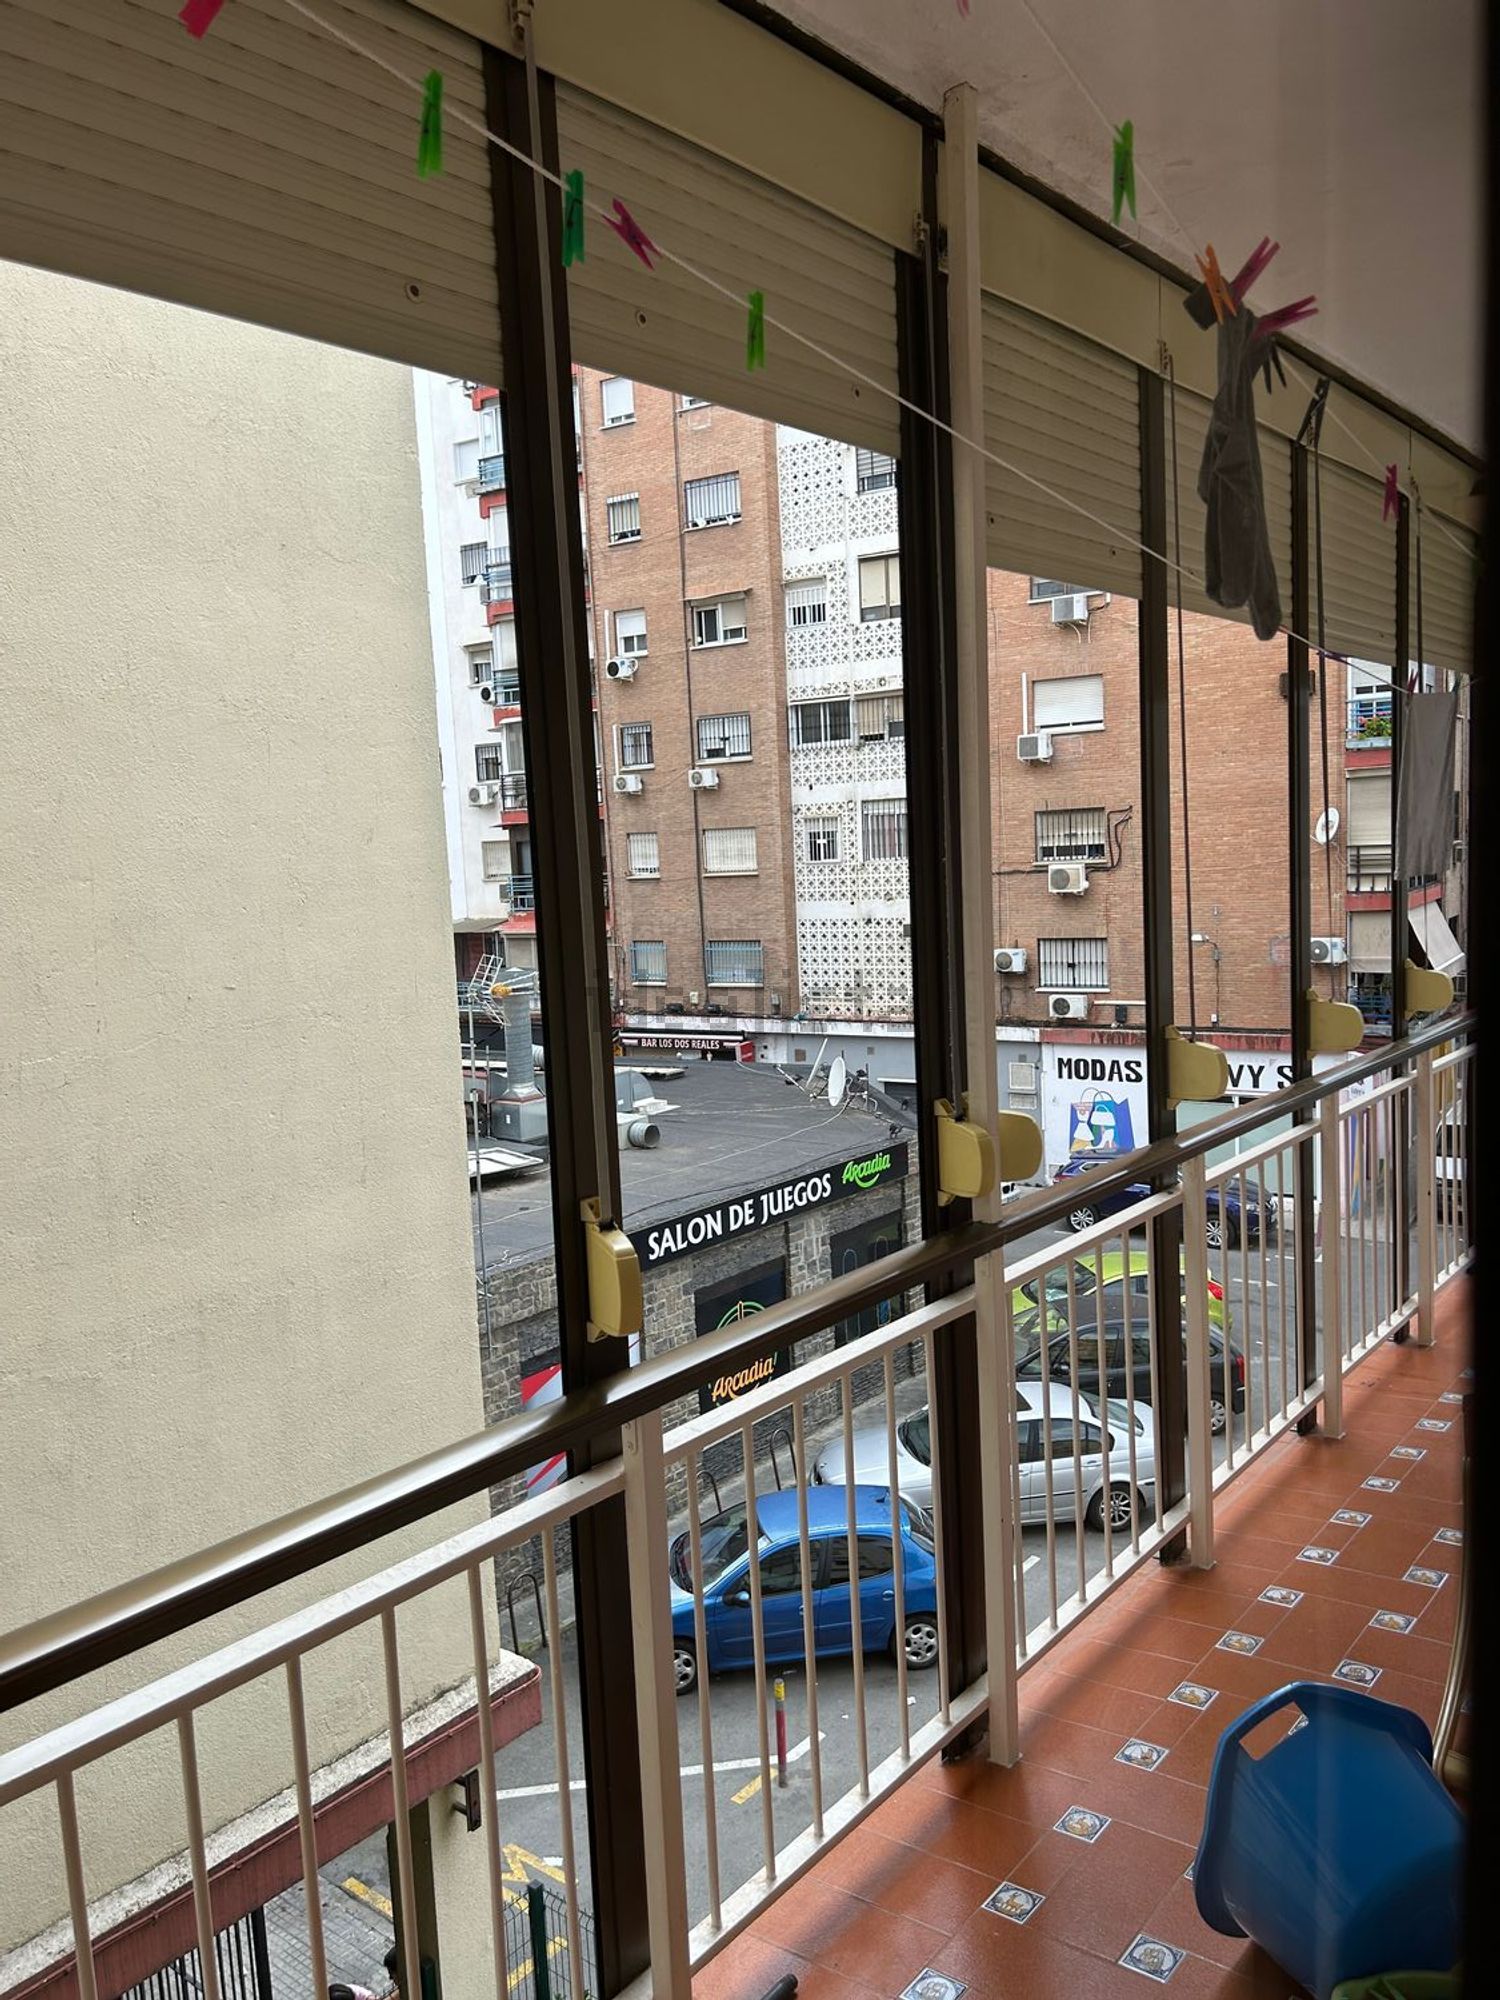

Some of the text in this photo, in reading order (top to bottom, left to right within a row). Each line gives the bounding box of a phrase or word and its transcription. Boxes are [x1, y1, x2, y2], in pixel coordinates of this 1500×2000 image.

[641, 1038, 720, 1050] BAR LOS DOS REALES
[1057, 1057, 1143, 1083] MODAS
[841, 1152, 892, 1187] Arcadia
[647, 1173, 832, 1260] SALON DE JUEGOS
[711, 1357, 775, 1402] Arcadia
